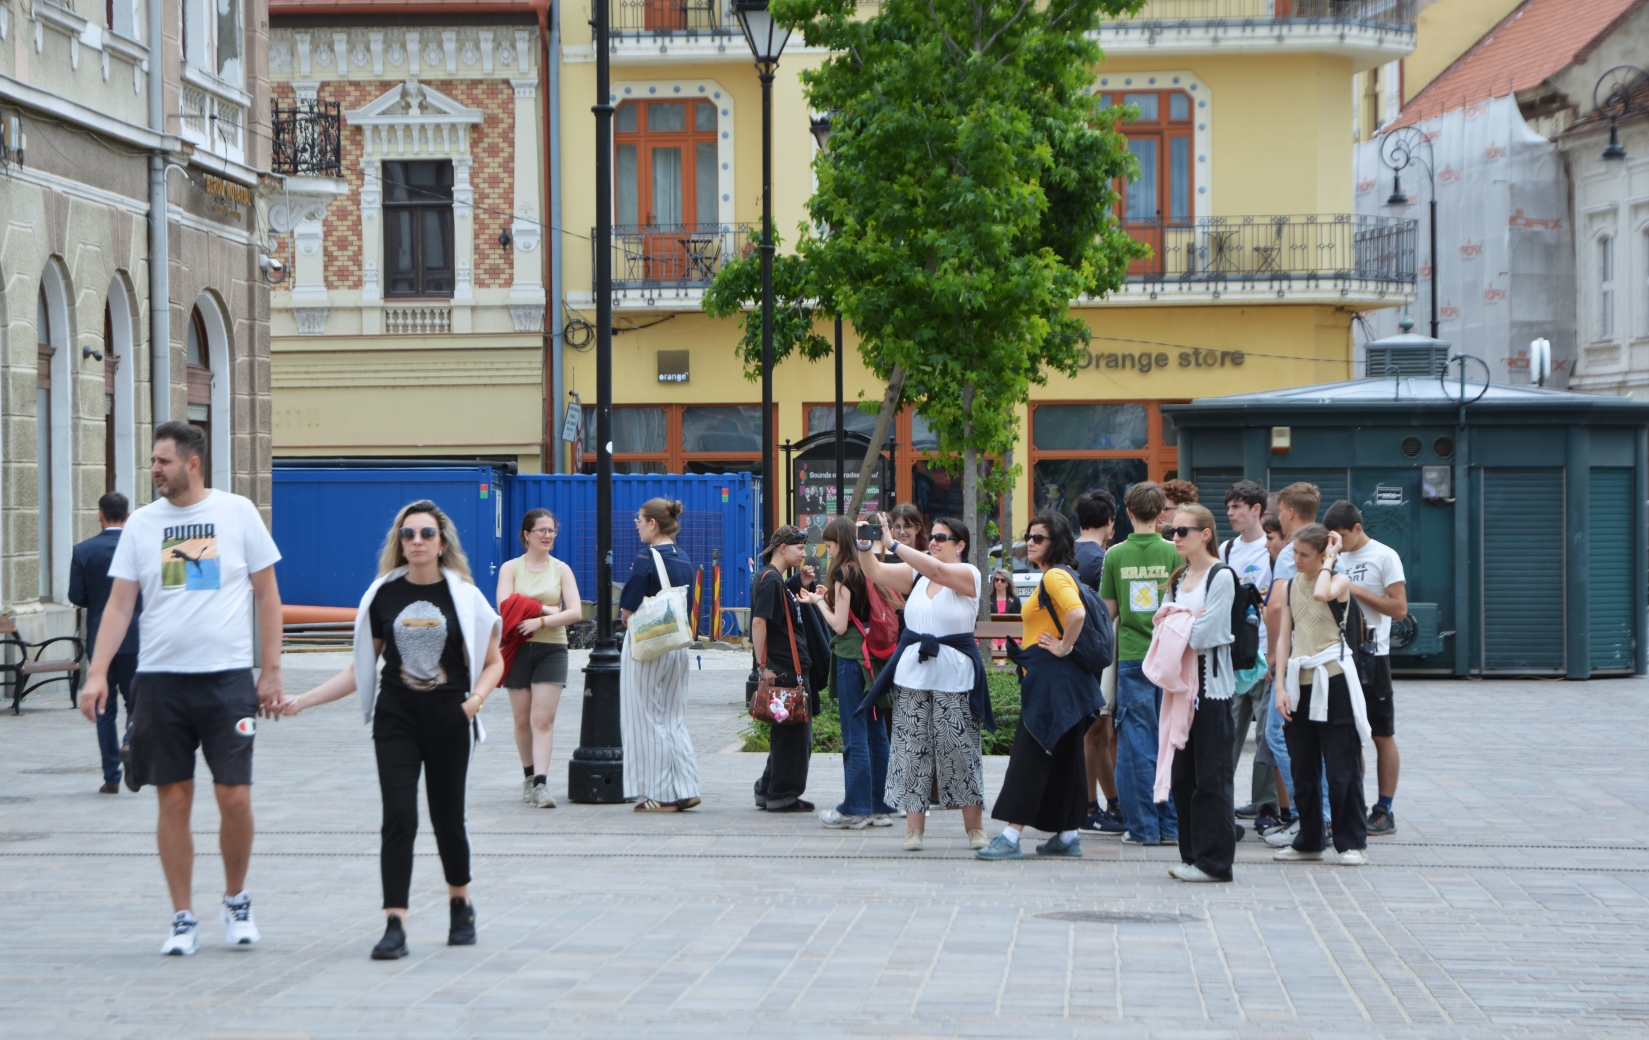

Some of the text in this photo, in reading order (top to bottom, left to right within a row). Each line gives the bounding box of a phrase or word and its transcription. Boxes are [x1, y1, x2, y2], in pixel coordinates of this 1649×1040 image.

[1076, 348, 1246, 373] Orange store
[809, 471, 831, 479] Sounds
[164, 524, 215, 542] PUMA
[1120, 566, 1169, 579] BRAZIL
